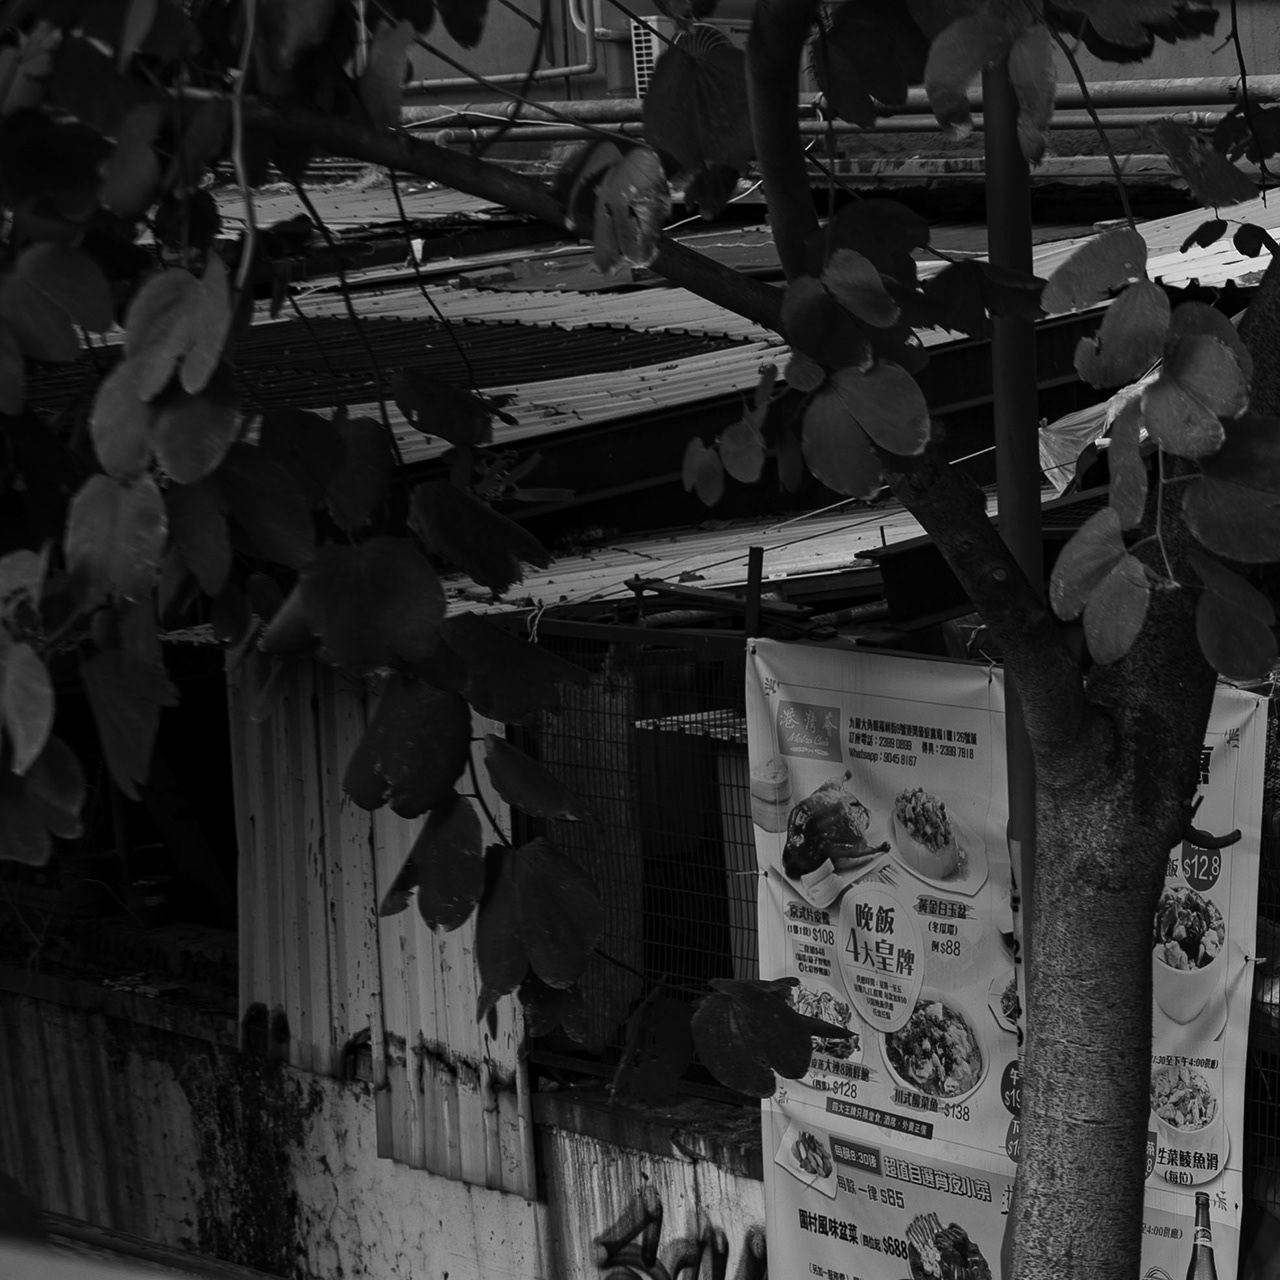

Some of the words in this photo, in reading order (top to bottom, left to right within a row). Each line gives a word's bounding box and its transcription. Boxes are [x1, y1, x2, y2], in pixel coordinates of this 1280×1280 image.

[1184, 853, 1220, 881] $12.8
[855, 902, 896, 935] 晚飯
[845, 927, 915, 976] 4大皇牌
[833, 1080, 858, 1099] $128
[943, 1103, 970, 1122] $138
[1157, 1147, 1219, 1171] 生菜鯪魚滑
[881, 1187, 905, 1209] $65
[882, 1235, 908, 1260] $688
